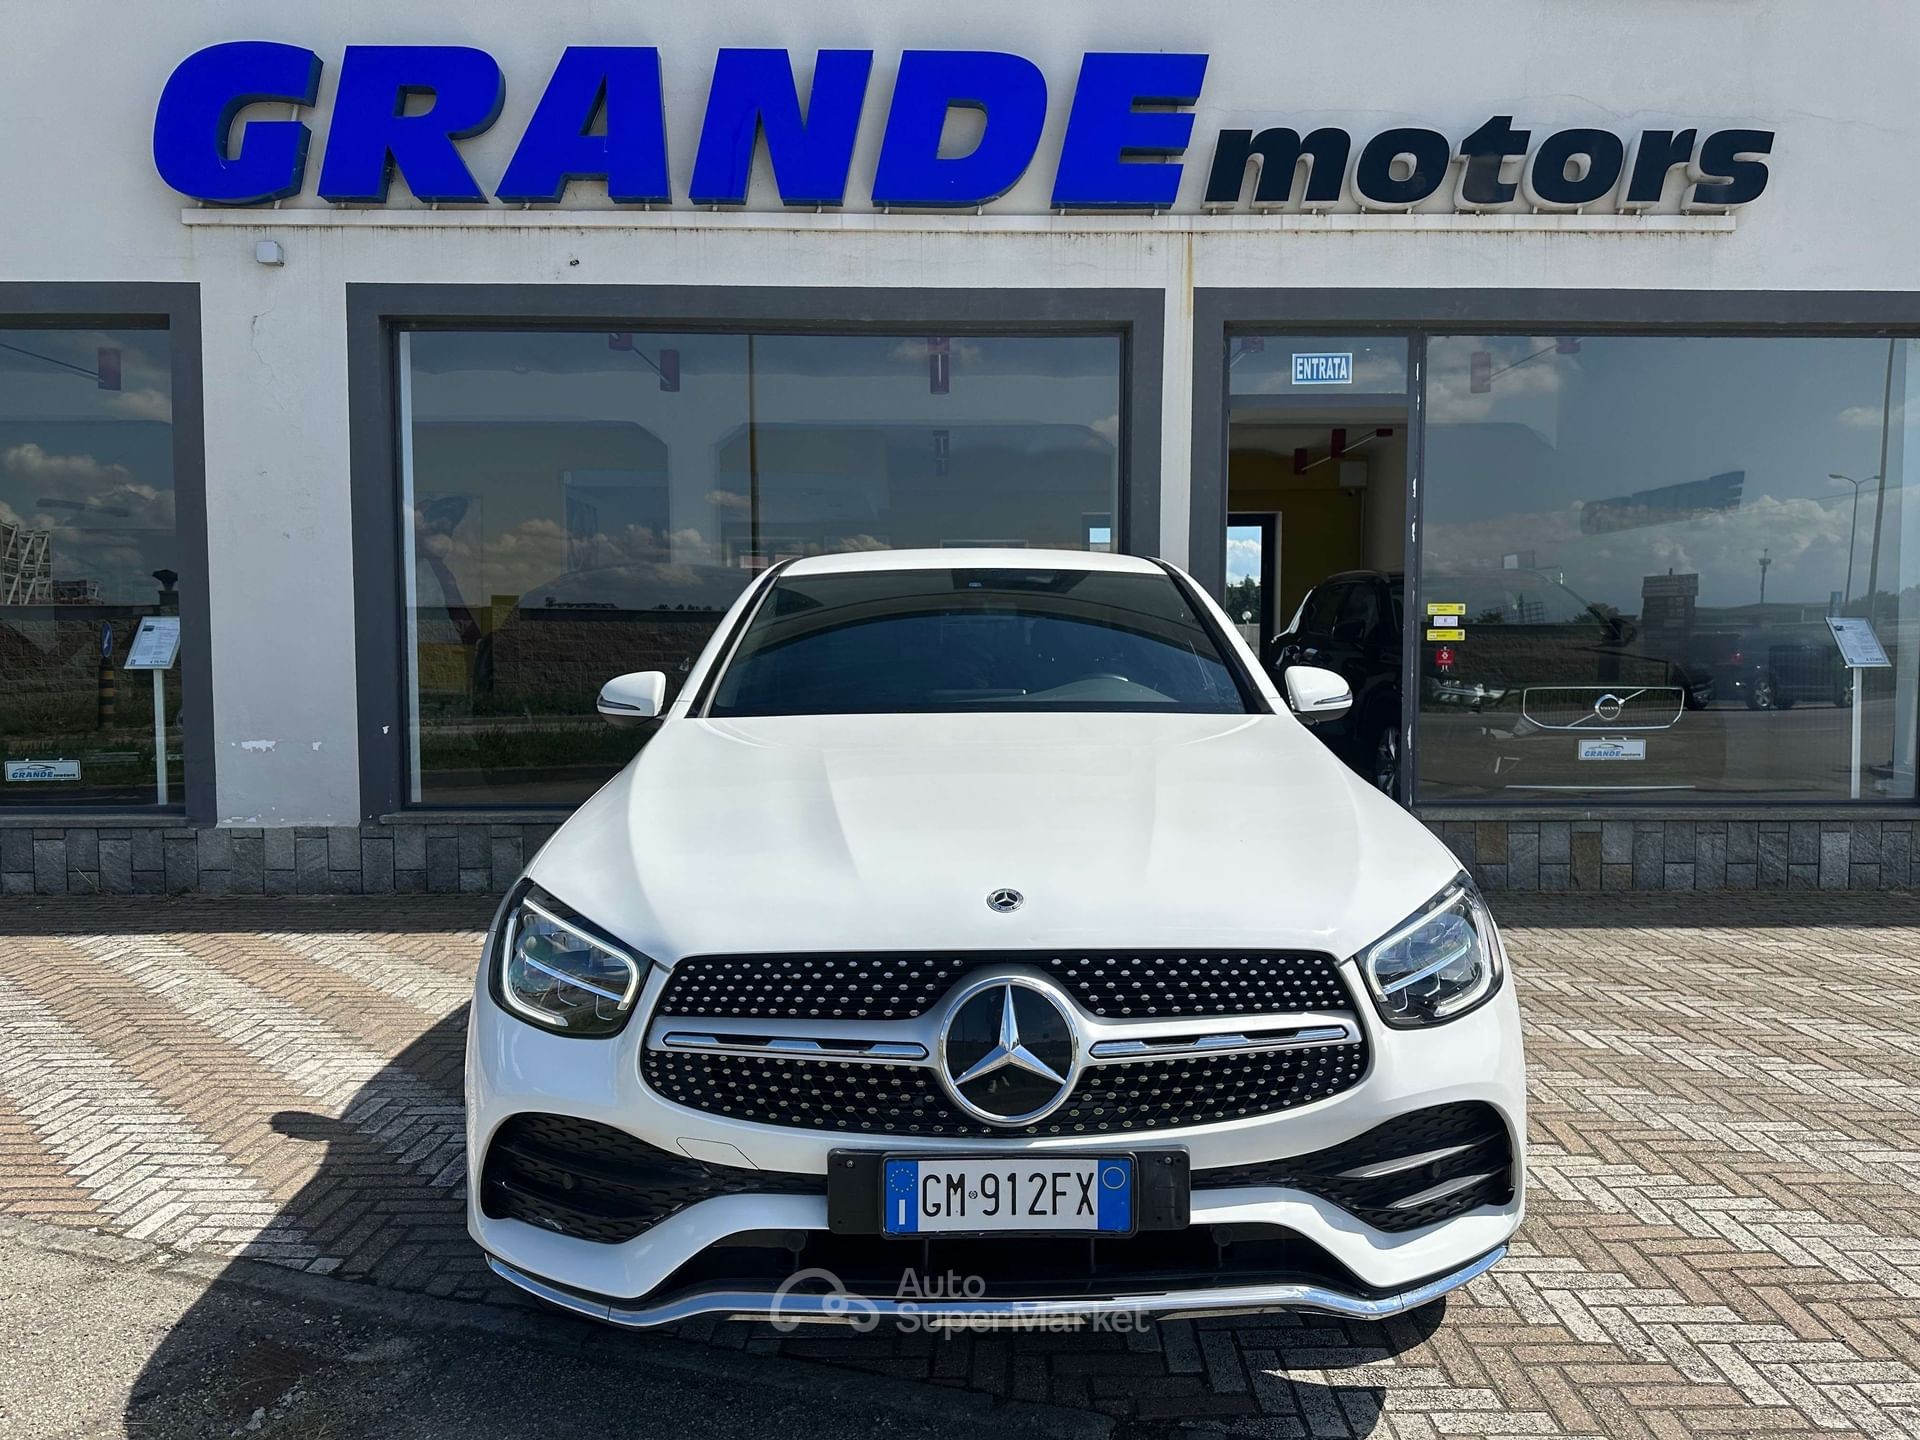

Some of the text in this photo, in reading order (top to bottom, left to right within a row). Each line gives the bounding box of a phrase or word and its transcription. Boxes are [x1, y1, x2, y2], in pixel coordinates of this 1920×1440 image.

[153, 40, 1775, 208] GRANDE motors
[1296, 357, 1348, 380] ENTRATA
[11, 771, 54, 779] GRANDE
